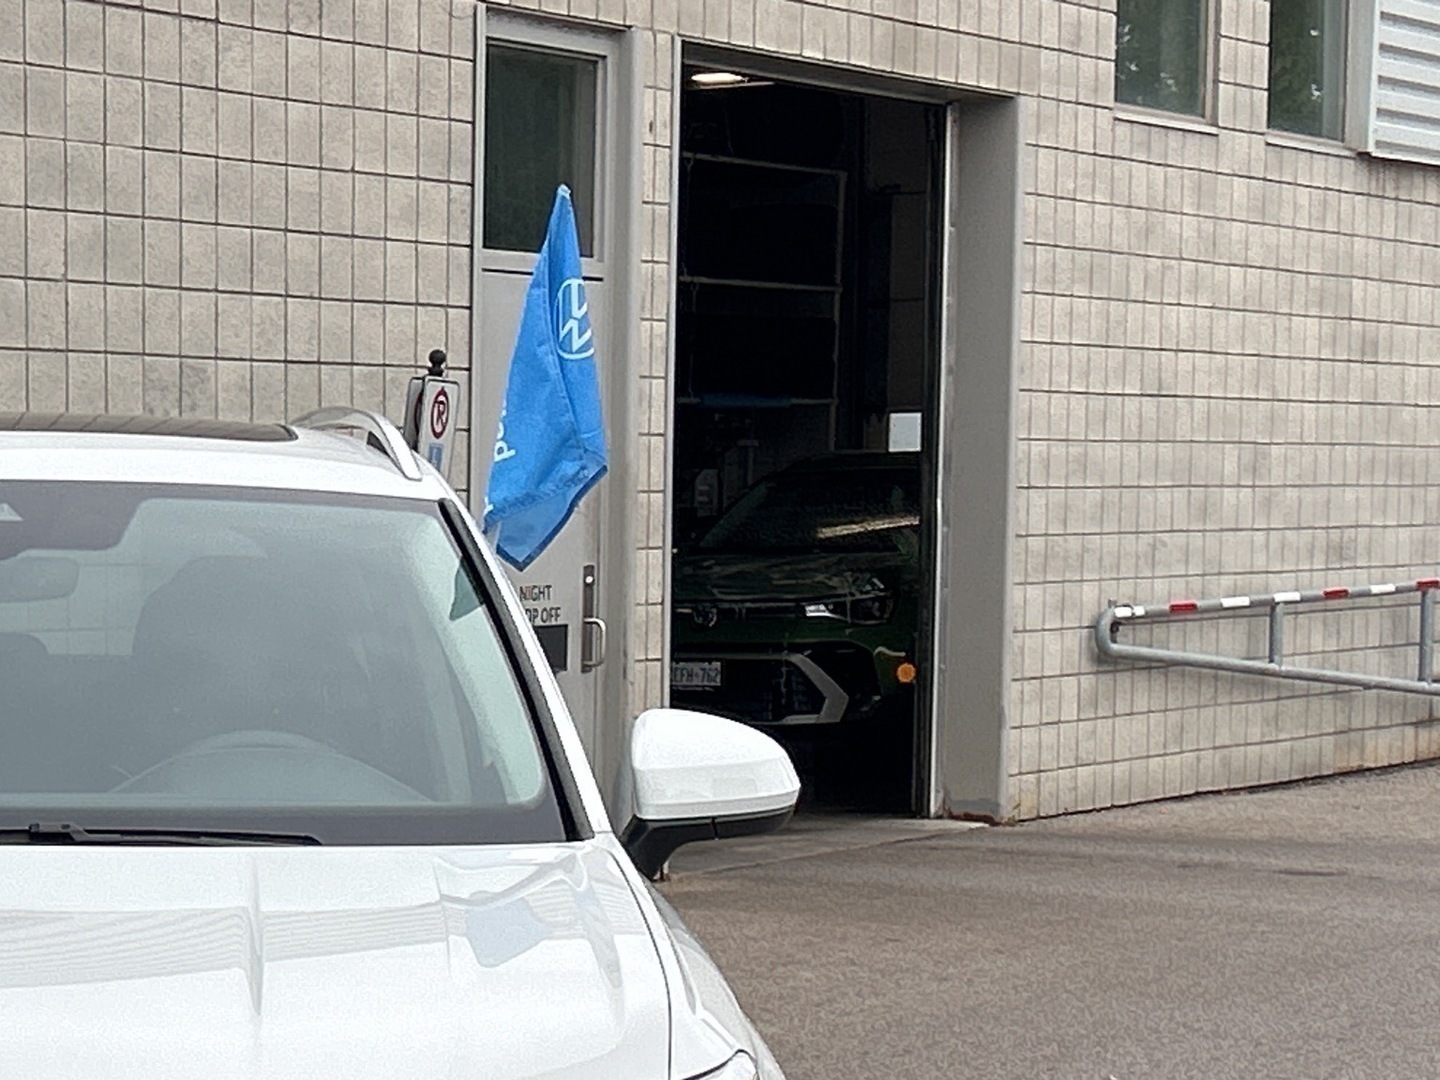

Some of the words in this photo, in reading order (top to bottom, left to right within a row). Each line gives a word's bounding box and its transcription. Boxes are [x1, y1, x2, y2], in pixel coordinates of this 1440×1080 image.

[520, 584, 552, 601] NIGHT
[525, 607, 539, 624] OP
[541, 606, 561, 623] OFF
